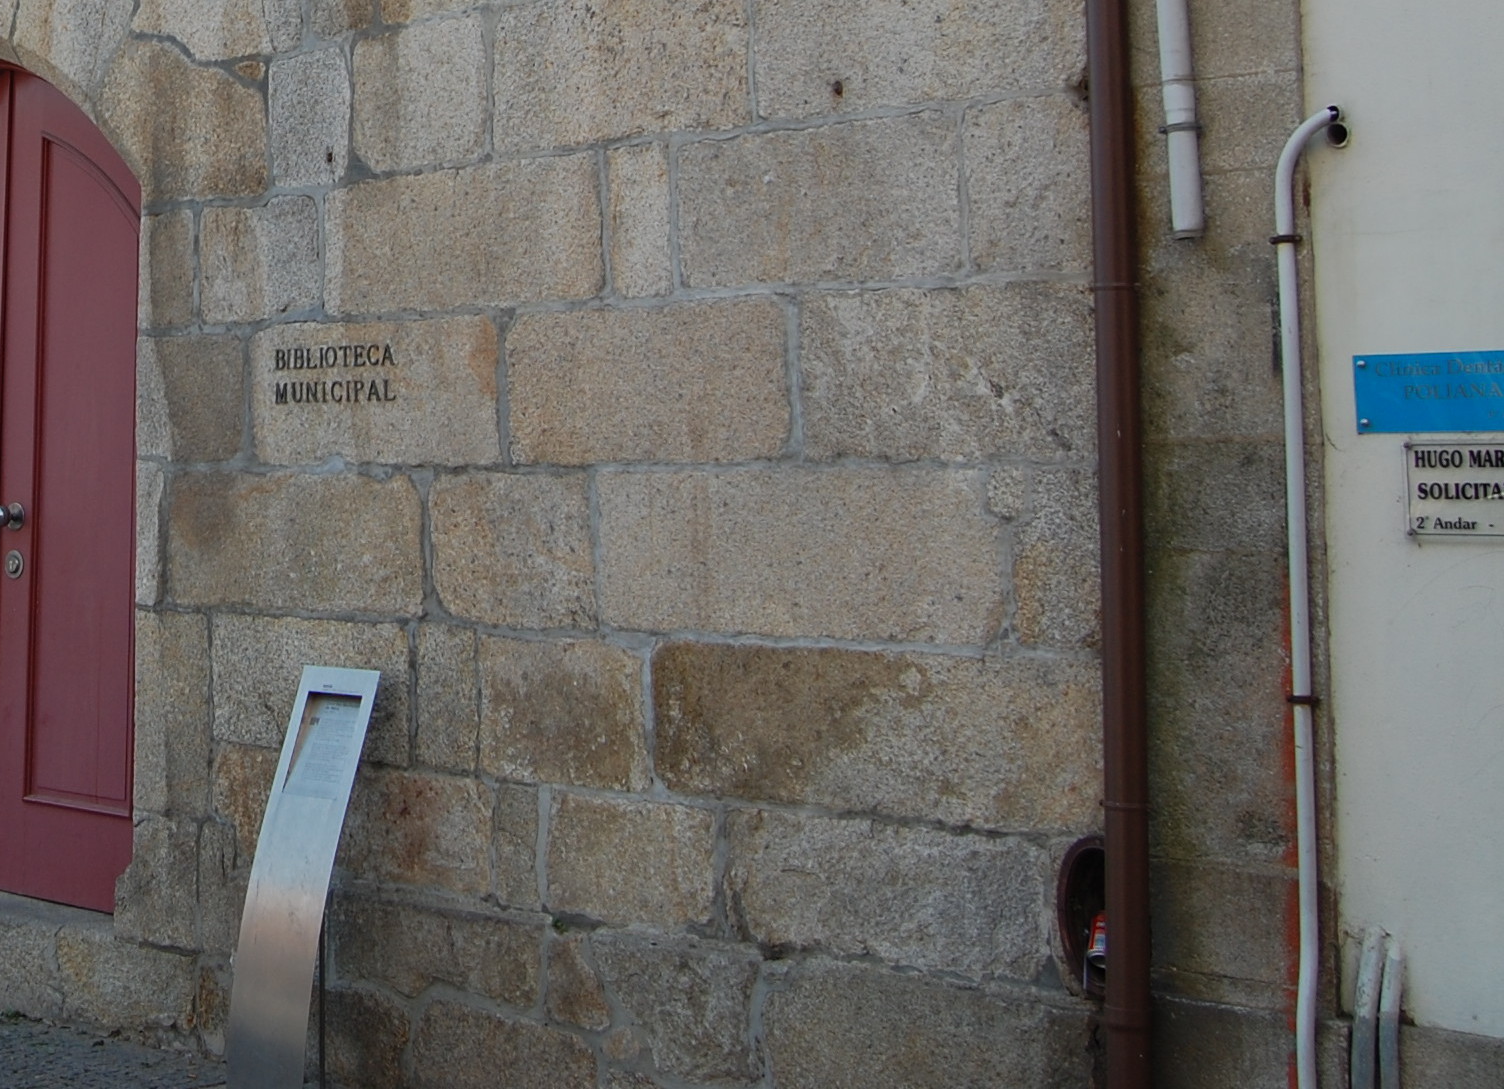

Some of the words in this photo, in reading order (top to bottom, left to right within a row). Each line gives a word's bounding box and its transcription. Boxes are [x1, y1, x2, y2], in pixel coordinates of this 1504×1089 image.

[275, 343, 396, 370] BIBLIOTECA
[275, 379, 397, 405] MUNICIPAL
[1414, 450, 1463, 468] HUGO
[1468, 450, 1504, 468] MAR
[1433, 517, 1477, 530] Andar
